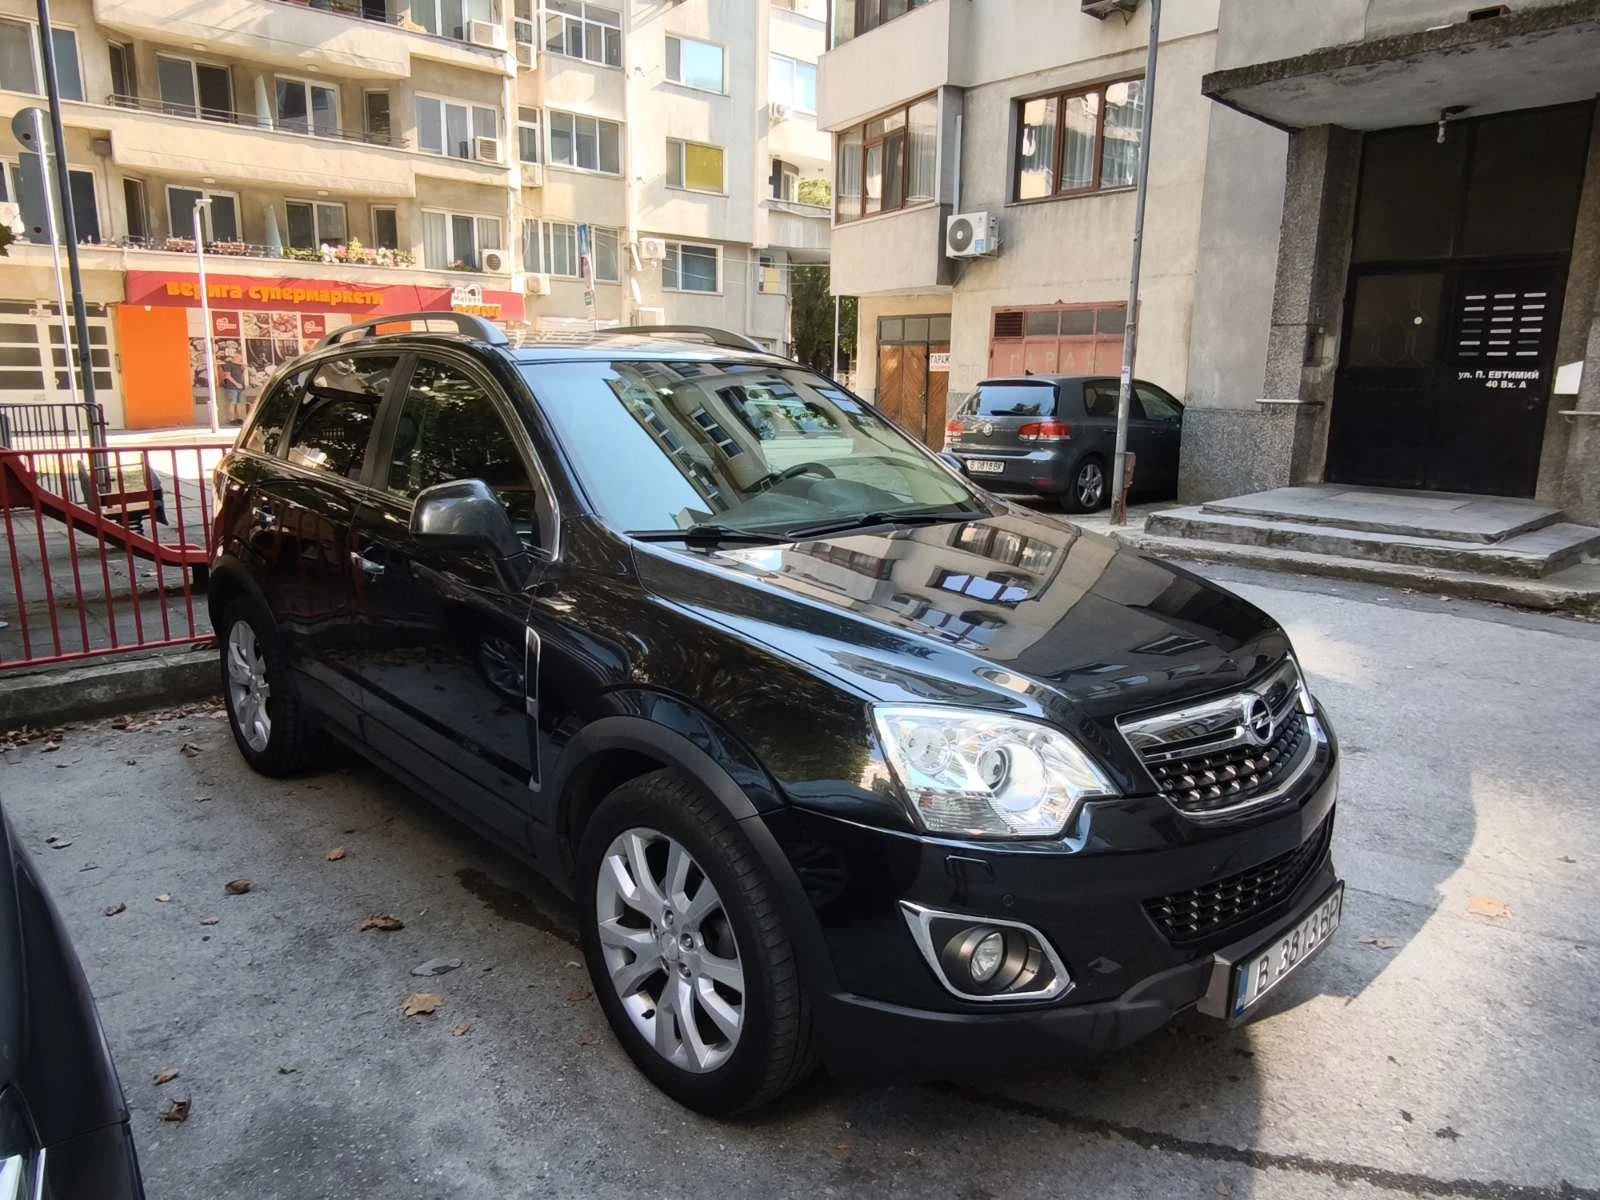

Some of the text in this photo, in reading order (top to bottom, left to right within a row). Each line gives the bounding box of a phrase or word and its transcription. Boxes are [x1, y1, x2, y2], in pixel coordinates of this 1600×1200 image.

[167, 281, 384, 306] верига супермаркети
[1458, 369, 1540, 380] ул. П. ЕВТИМИЙ
[1485, 380, 1498, 388] 40
[1500, 380, 1516, 389] Вх.
